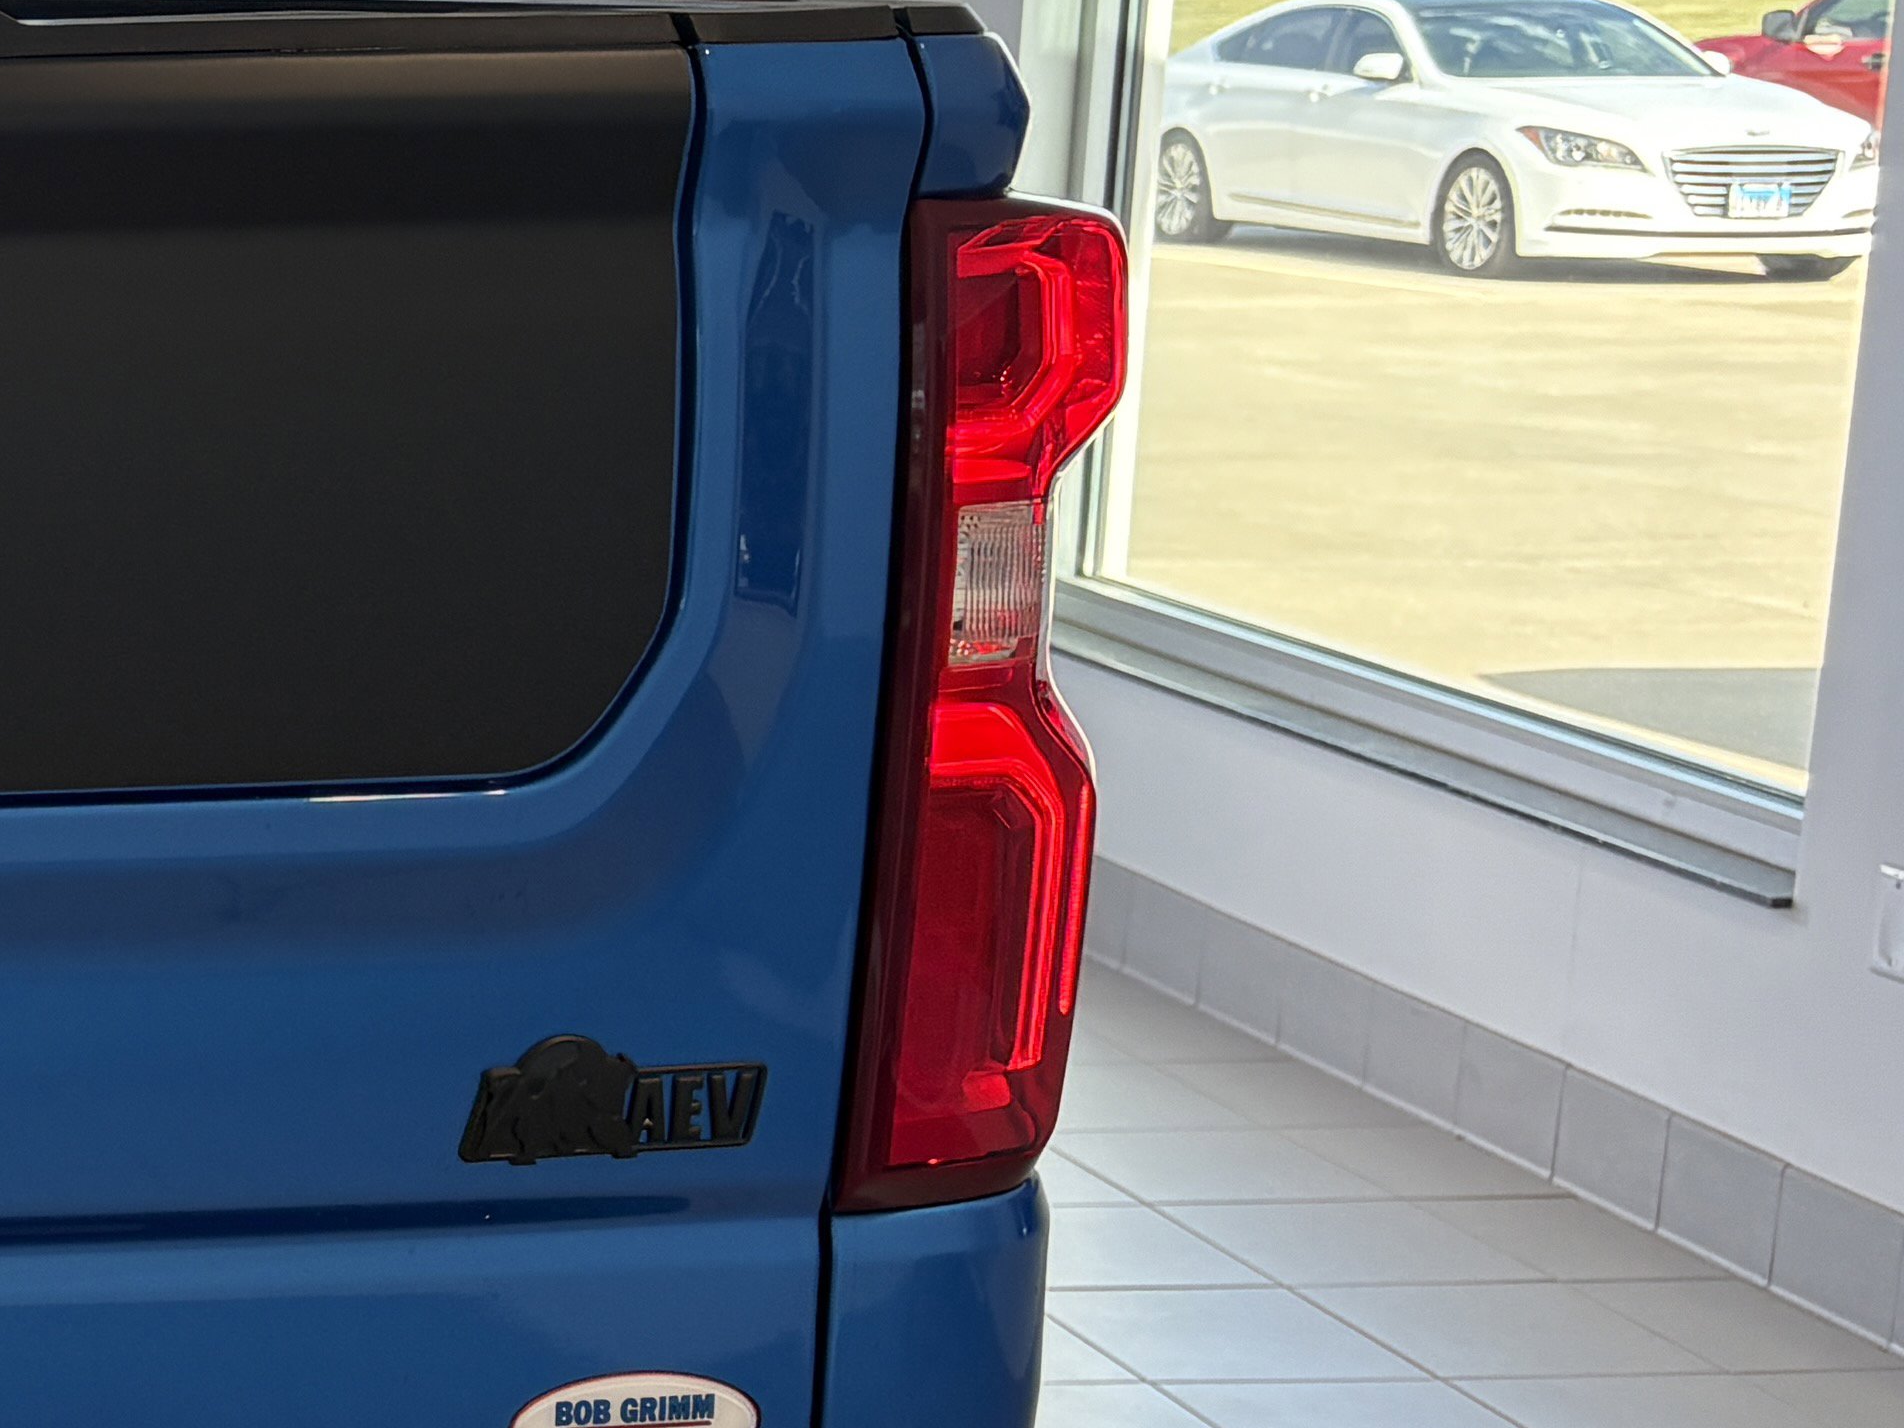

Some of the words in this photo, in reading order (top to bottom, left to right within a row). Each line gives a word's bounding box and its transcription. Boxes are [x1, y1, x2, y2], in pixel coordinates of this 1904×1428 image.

[625, 1072, 754, 1144] AEV
[555, 1399, 611, 1426] BOB
[620, 1393, 716, 1423] GRIMM
